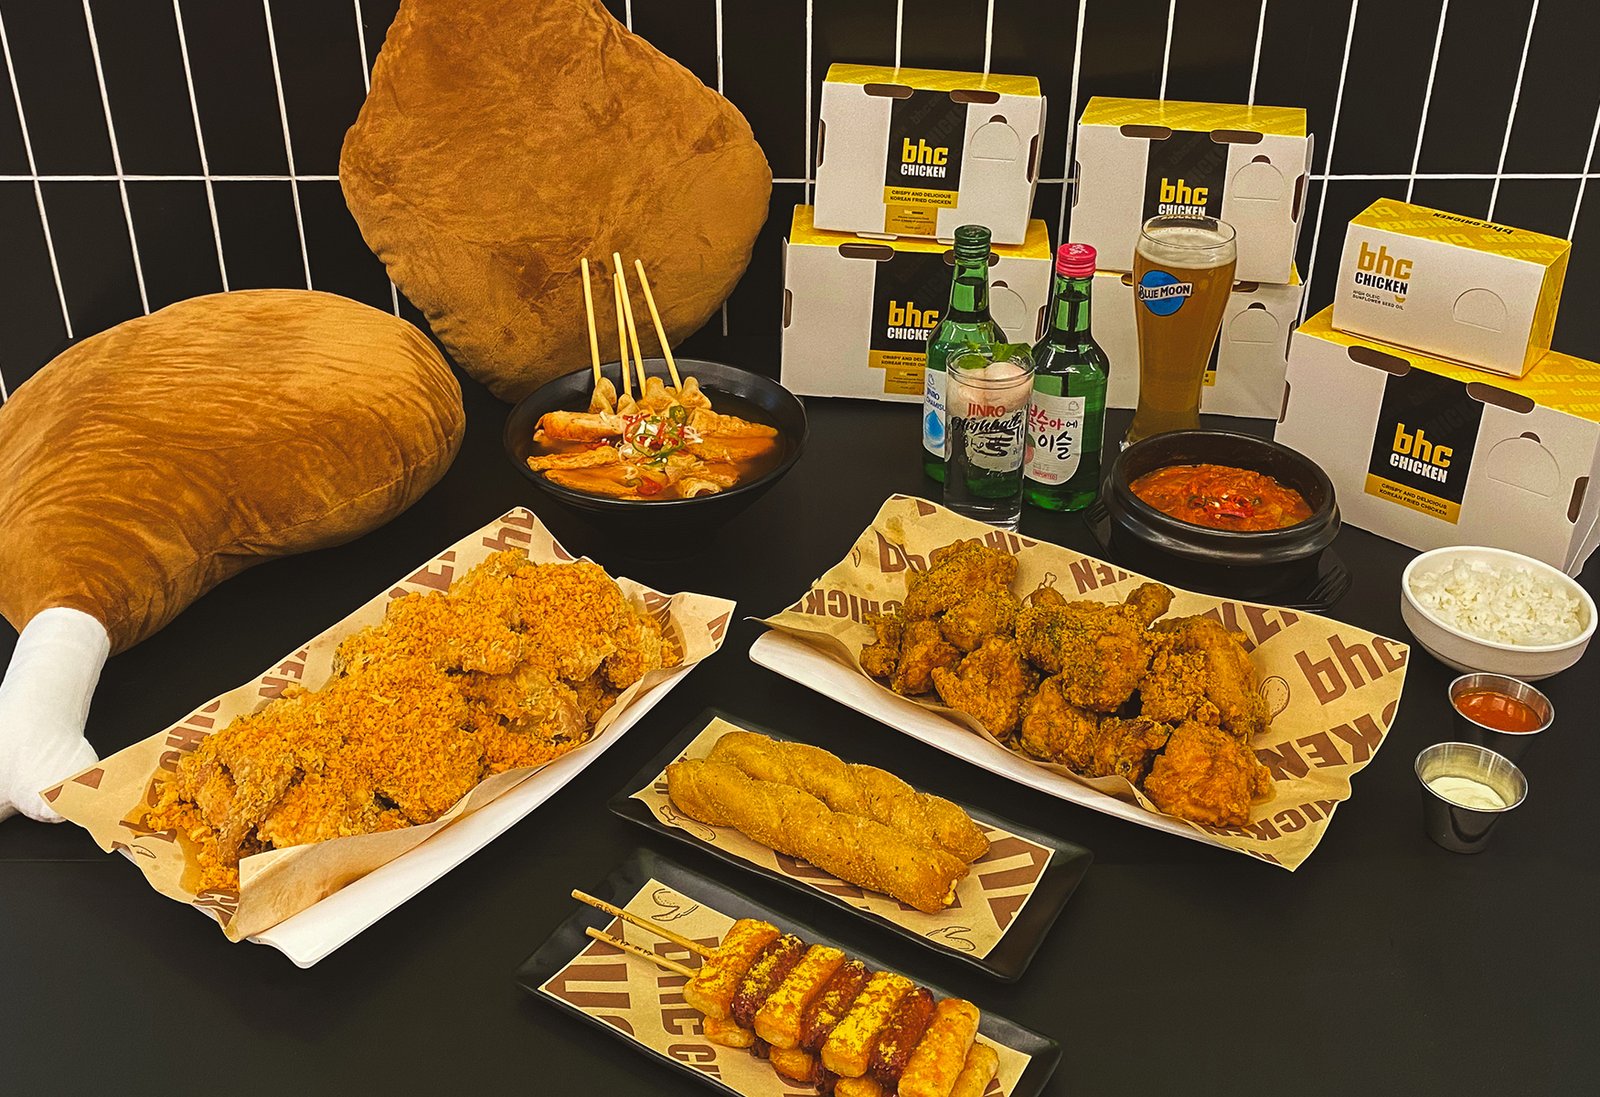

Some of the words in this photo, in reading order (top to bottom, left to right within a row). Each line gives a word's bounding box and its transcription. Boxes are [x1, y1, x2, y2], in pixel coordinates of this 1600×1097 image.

[902, 137, 949, 166] bhc
[900, 163, 947, 178] CHICKEN
[924, 191, 951, 199] DELICIOUS
[1160, 178, 1209, 206] bhc
[1158, 203, 1206, 218] CHICKEN
[1357, 241, 1413, 280] bhc
[1138, 285, 1159, 299] BLUE
[1160, 284, 1190, 298] MOON
[1354, 272, 1408, 295] CHICKEN
[1366, 292, 1380, 300] OLEIC
[1352, 294, 1381, 305] SUNFLOWER
[888, 300, 939, 329] bhc
[887, 326, 932, 341] CHICKE
[967, 403, 1006, 418] JINRO
[1038, 431, 1073, 460] 이슬
[1392, 422, 1454, 468] bhc
[1389, 453, 1448, 484] CHICKEN
[1379, 489, 1402, 500] KOREAN
[1404, 497, 1420, 506] FRIED
[1420, 503, 1447, 516] CHICKEN
[1381, 483, 1402, 494] CRISPY
[1403, 490, 1416, 499] AND
[1416, 495, 1447, 510] DELICIOUS
[1294, 634, 1408, 706] bhc
